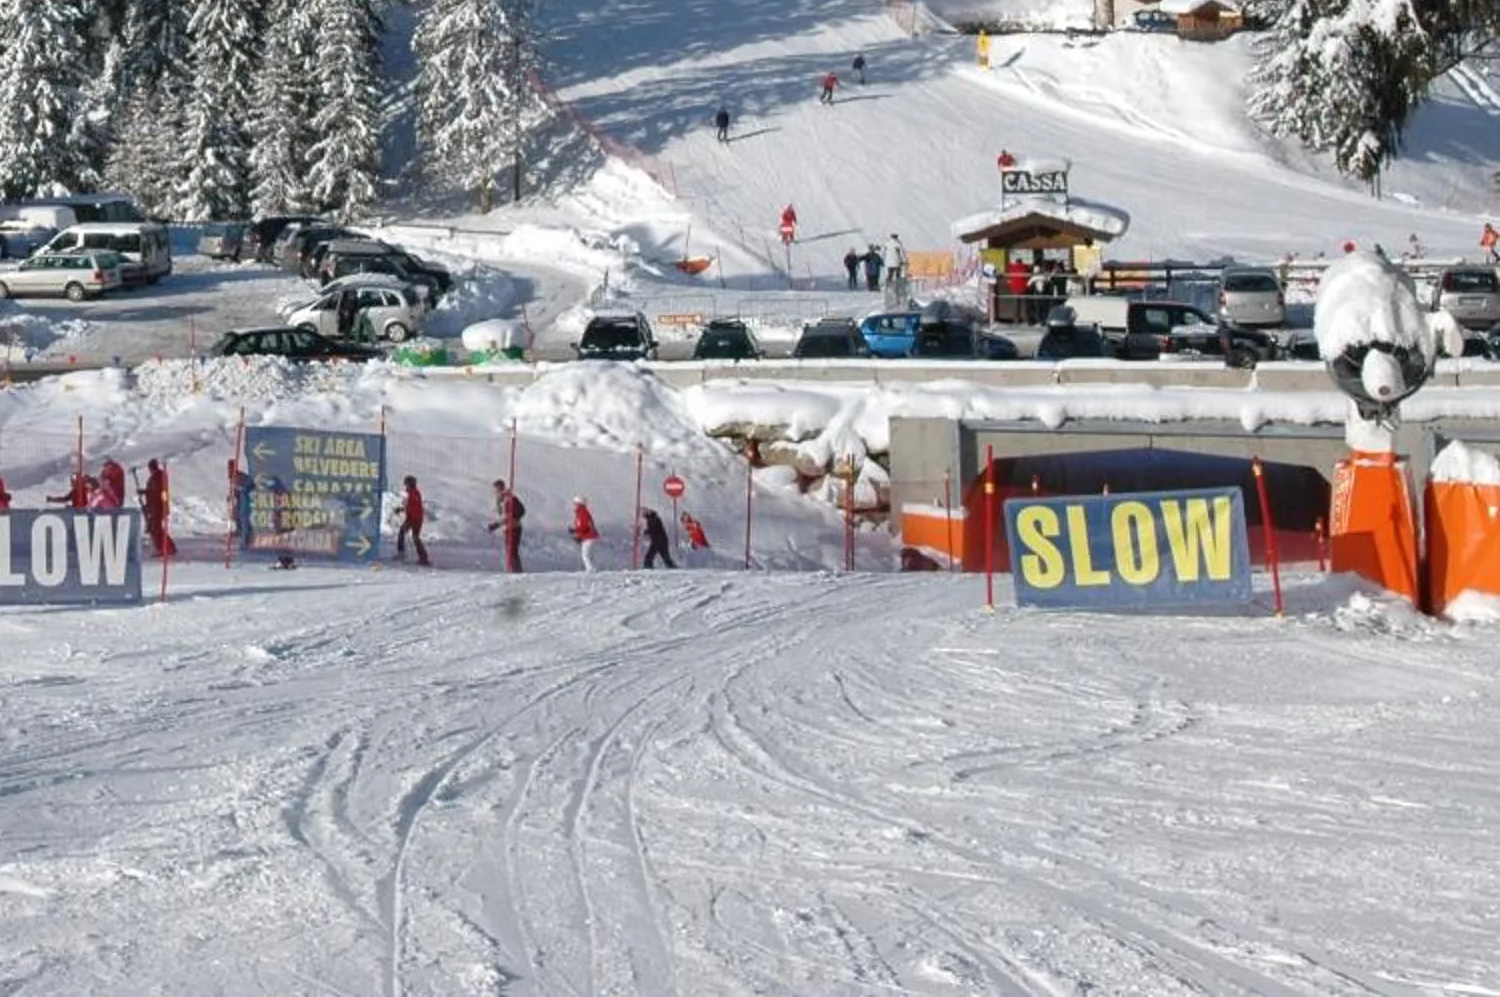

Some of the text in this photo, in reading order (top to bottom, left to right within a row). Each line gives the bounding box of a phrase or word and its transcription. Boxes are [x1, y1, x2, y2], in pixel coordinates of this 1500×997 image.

[1003, 173, 1067, 191] CASSA
[295, 435, 365, 457] SKI AREA
[1016, 496, 1231, 588] SLOW
